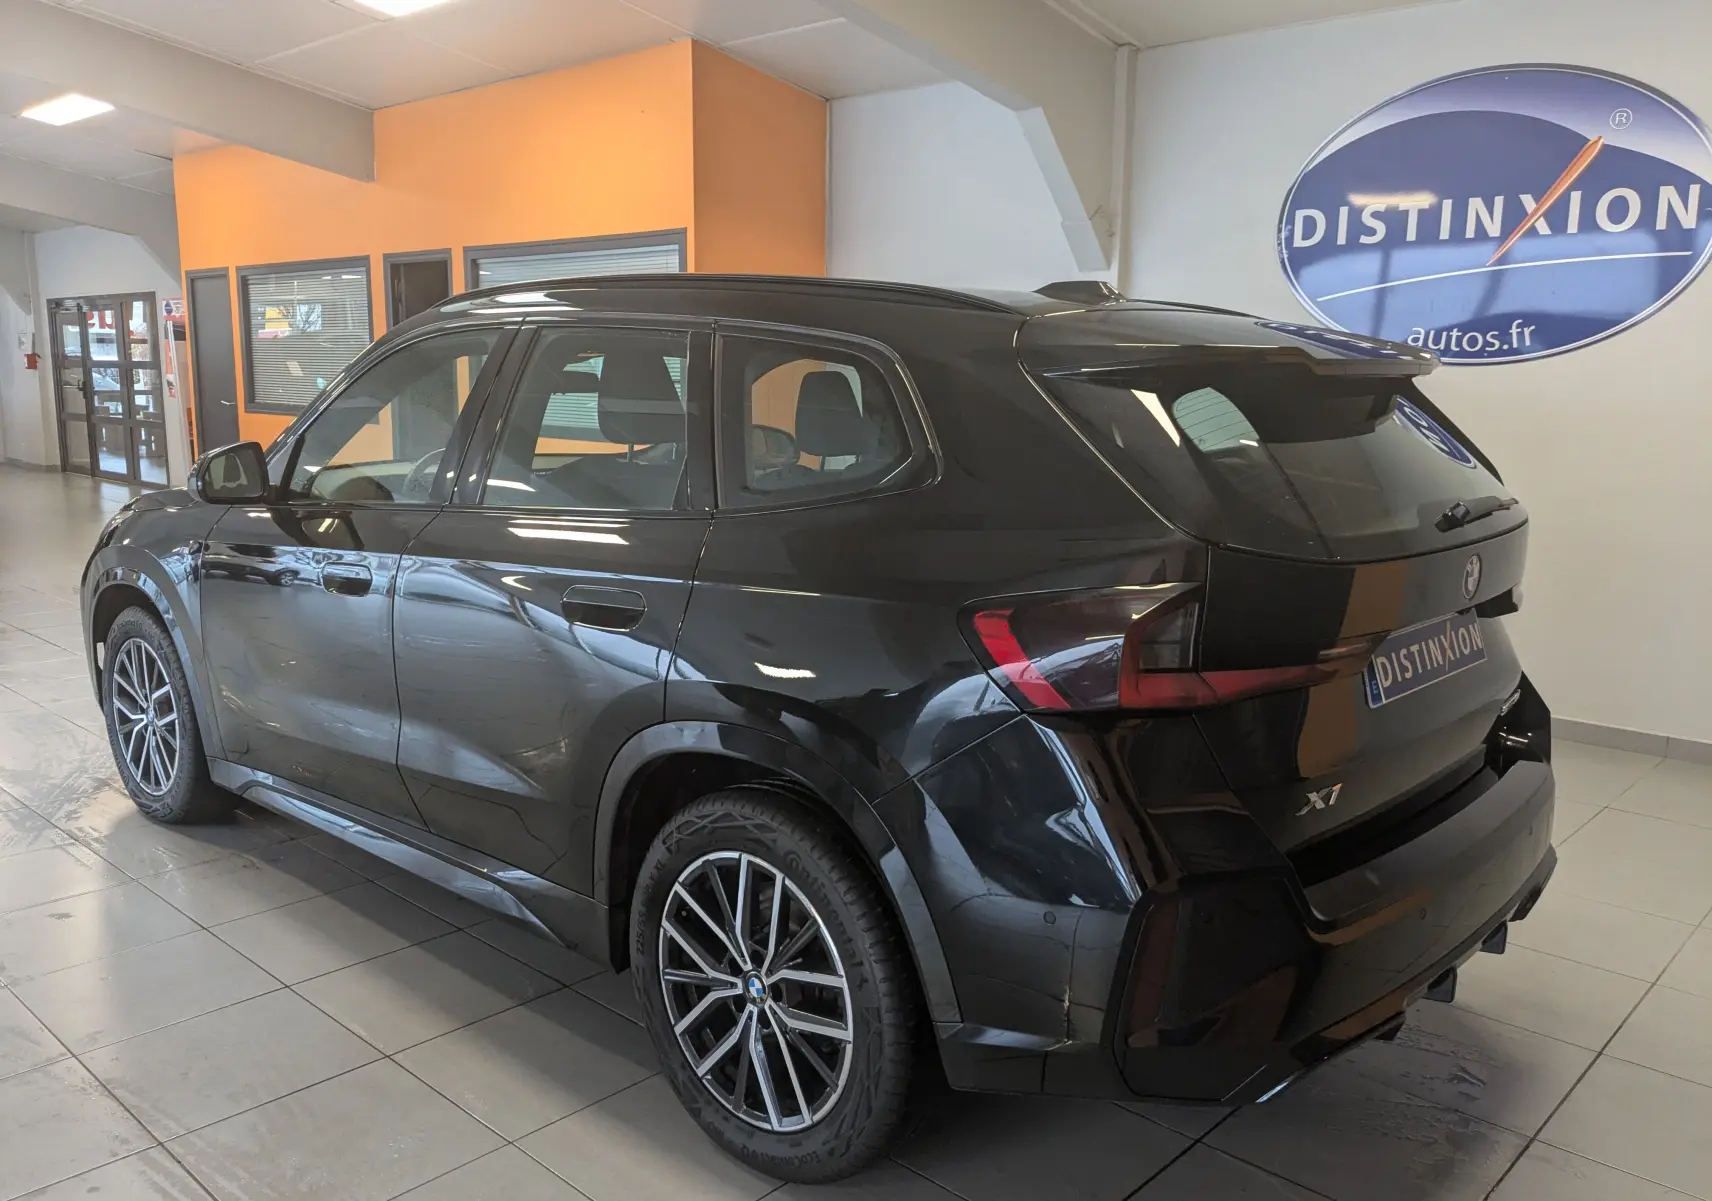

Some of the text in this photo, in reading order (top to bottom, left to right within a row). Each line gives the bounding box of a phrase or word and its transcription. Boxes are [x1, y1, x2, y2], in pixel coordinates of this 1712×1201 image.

[1293, 183, 1701, 265] DISTINXION
[1407, 319, 1536, 352] autos.fr
[1376, 621, 1484, 689] DISTINXION
